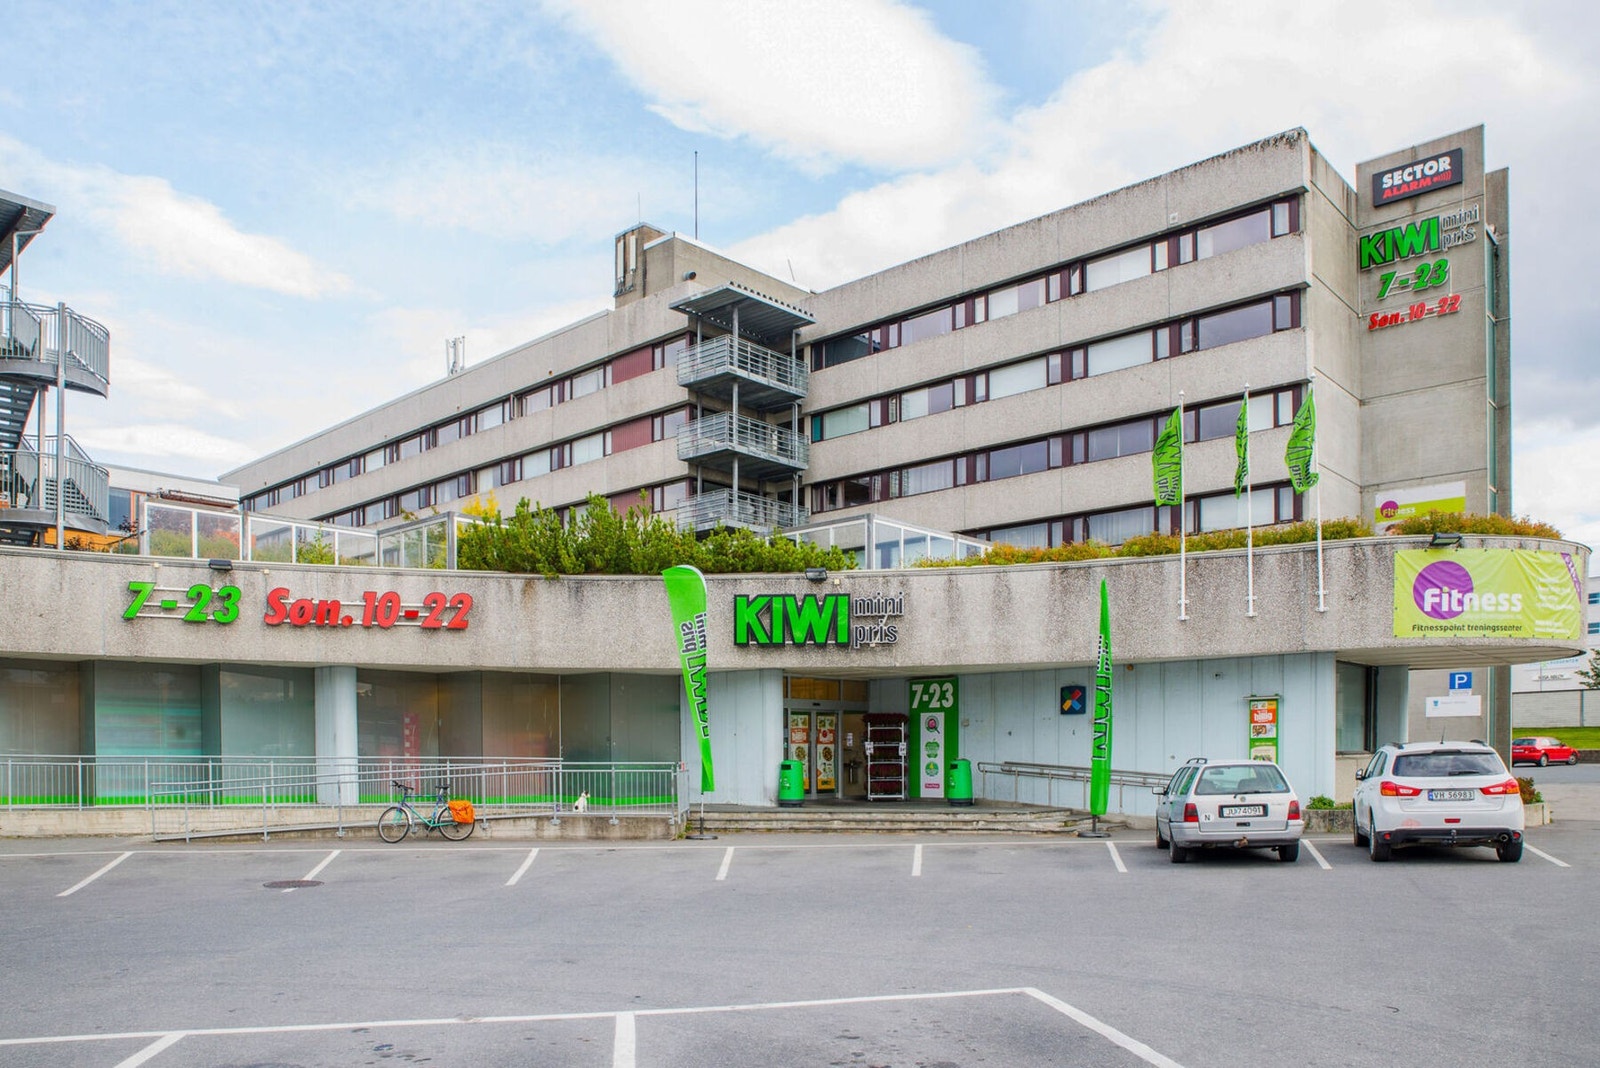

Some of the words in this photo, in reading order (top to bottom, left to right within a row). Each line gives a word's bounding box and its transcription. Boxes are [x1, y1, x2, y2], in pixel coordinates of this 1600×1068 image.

[1382, 156, 1451, 189] SECTOR
[1383, 178, 1432, 199] ALARM
[1360, 216, 1440, 270] KIWI
[1442, 205, 1480, 229] mini
[1442, 226, 1476, 251] pris
[1289, 464, 1304, 488] pris
[264, 587, 353, 627] Søn.
[1423, 586, 1522, 612] Fitness
[734, 594, 851, 646] KIWI
[854, 592, 905, 616] mini
[1412, 624, 1465, 633] Fitnesspoint
[1467, 624, 1522, 633] treningssenter
[854, 619, 898, 648] pris
[1455, 674, 1468, 689] P
[1433, 791, 1445, 799] VH
[1448, 791, 1473, 799] 56983
